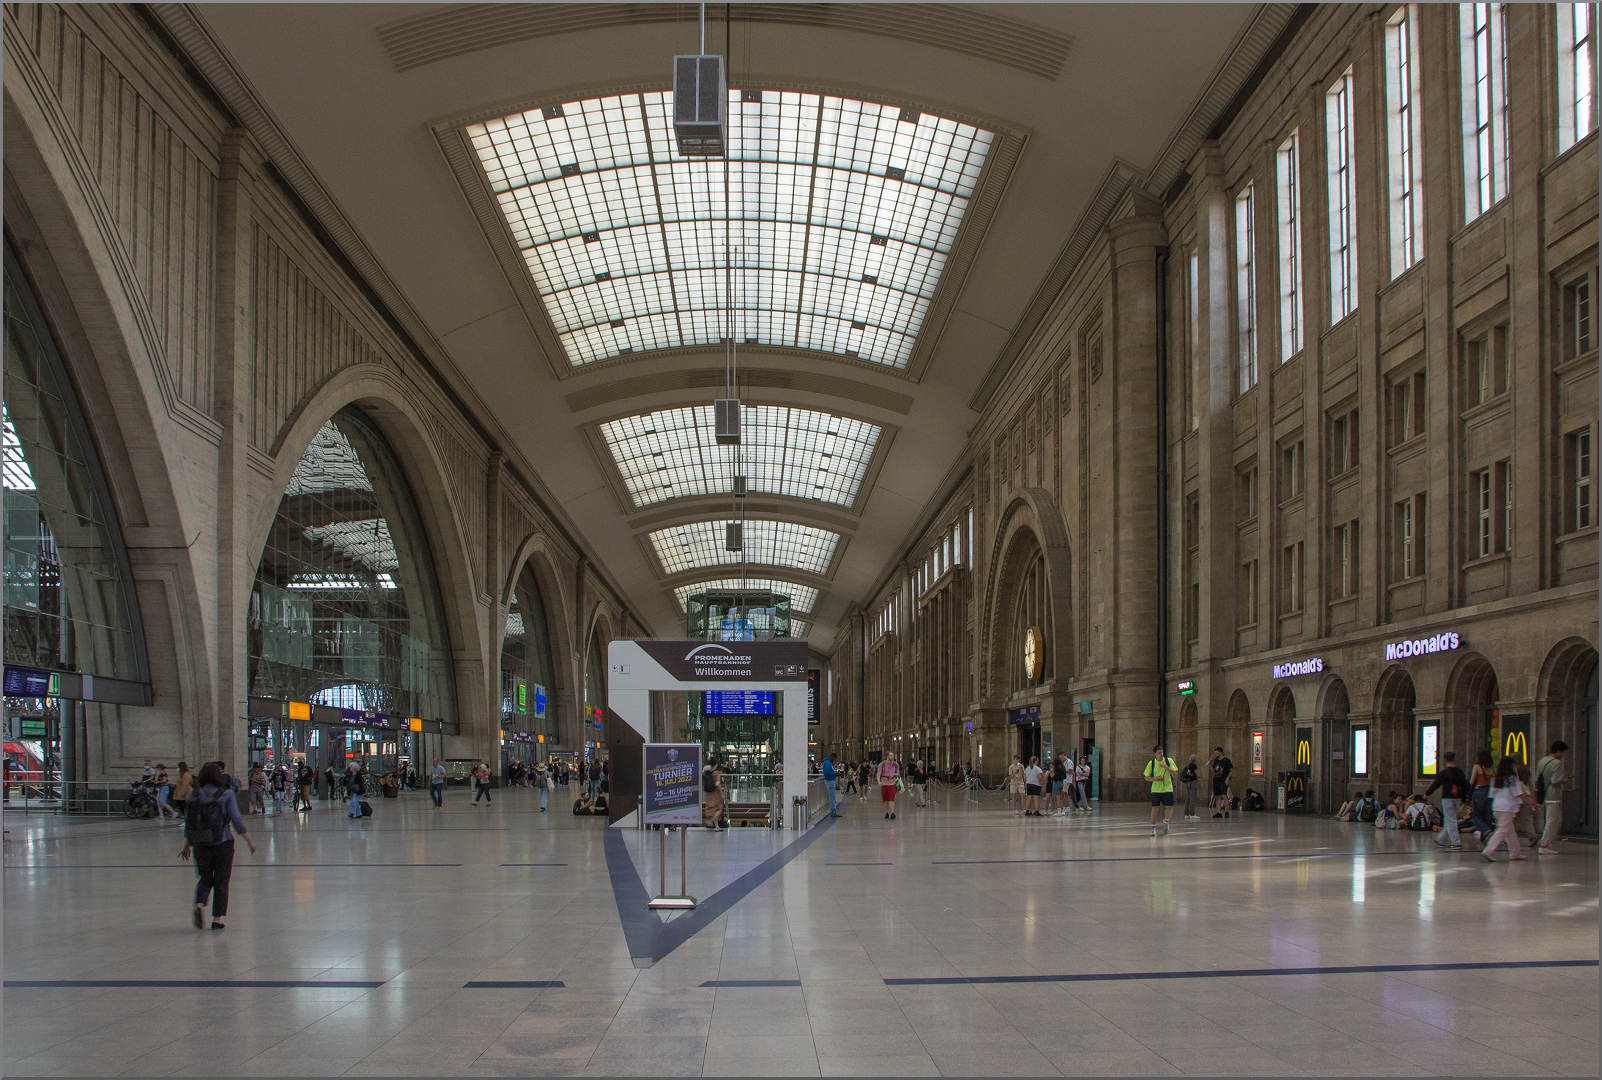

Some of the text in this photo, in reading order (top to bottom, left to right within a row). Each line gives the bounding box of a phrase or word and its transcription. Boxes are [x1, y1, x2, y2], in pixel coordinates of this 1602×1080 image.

[1386, 632, 1460, 661] McDonald's
[695, 667, 752, 676] Willkommen
[1273, 657, 1323, 680] McDonald's
[1178, 682, 1190, 690] SPAR
[653, 768, 693, 781] TURNIER
[664, 778, 677, 786] JULI
